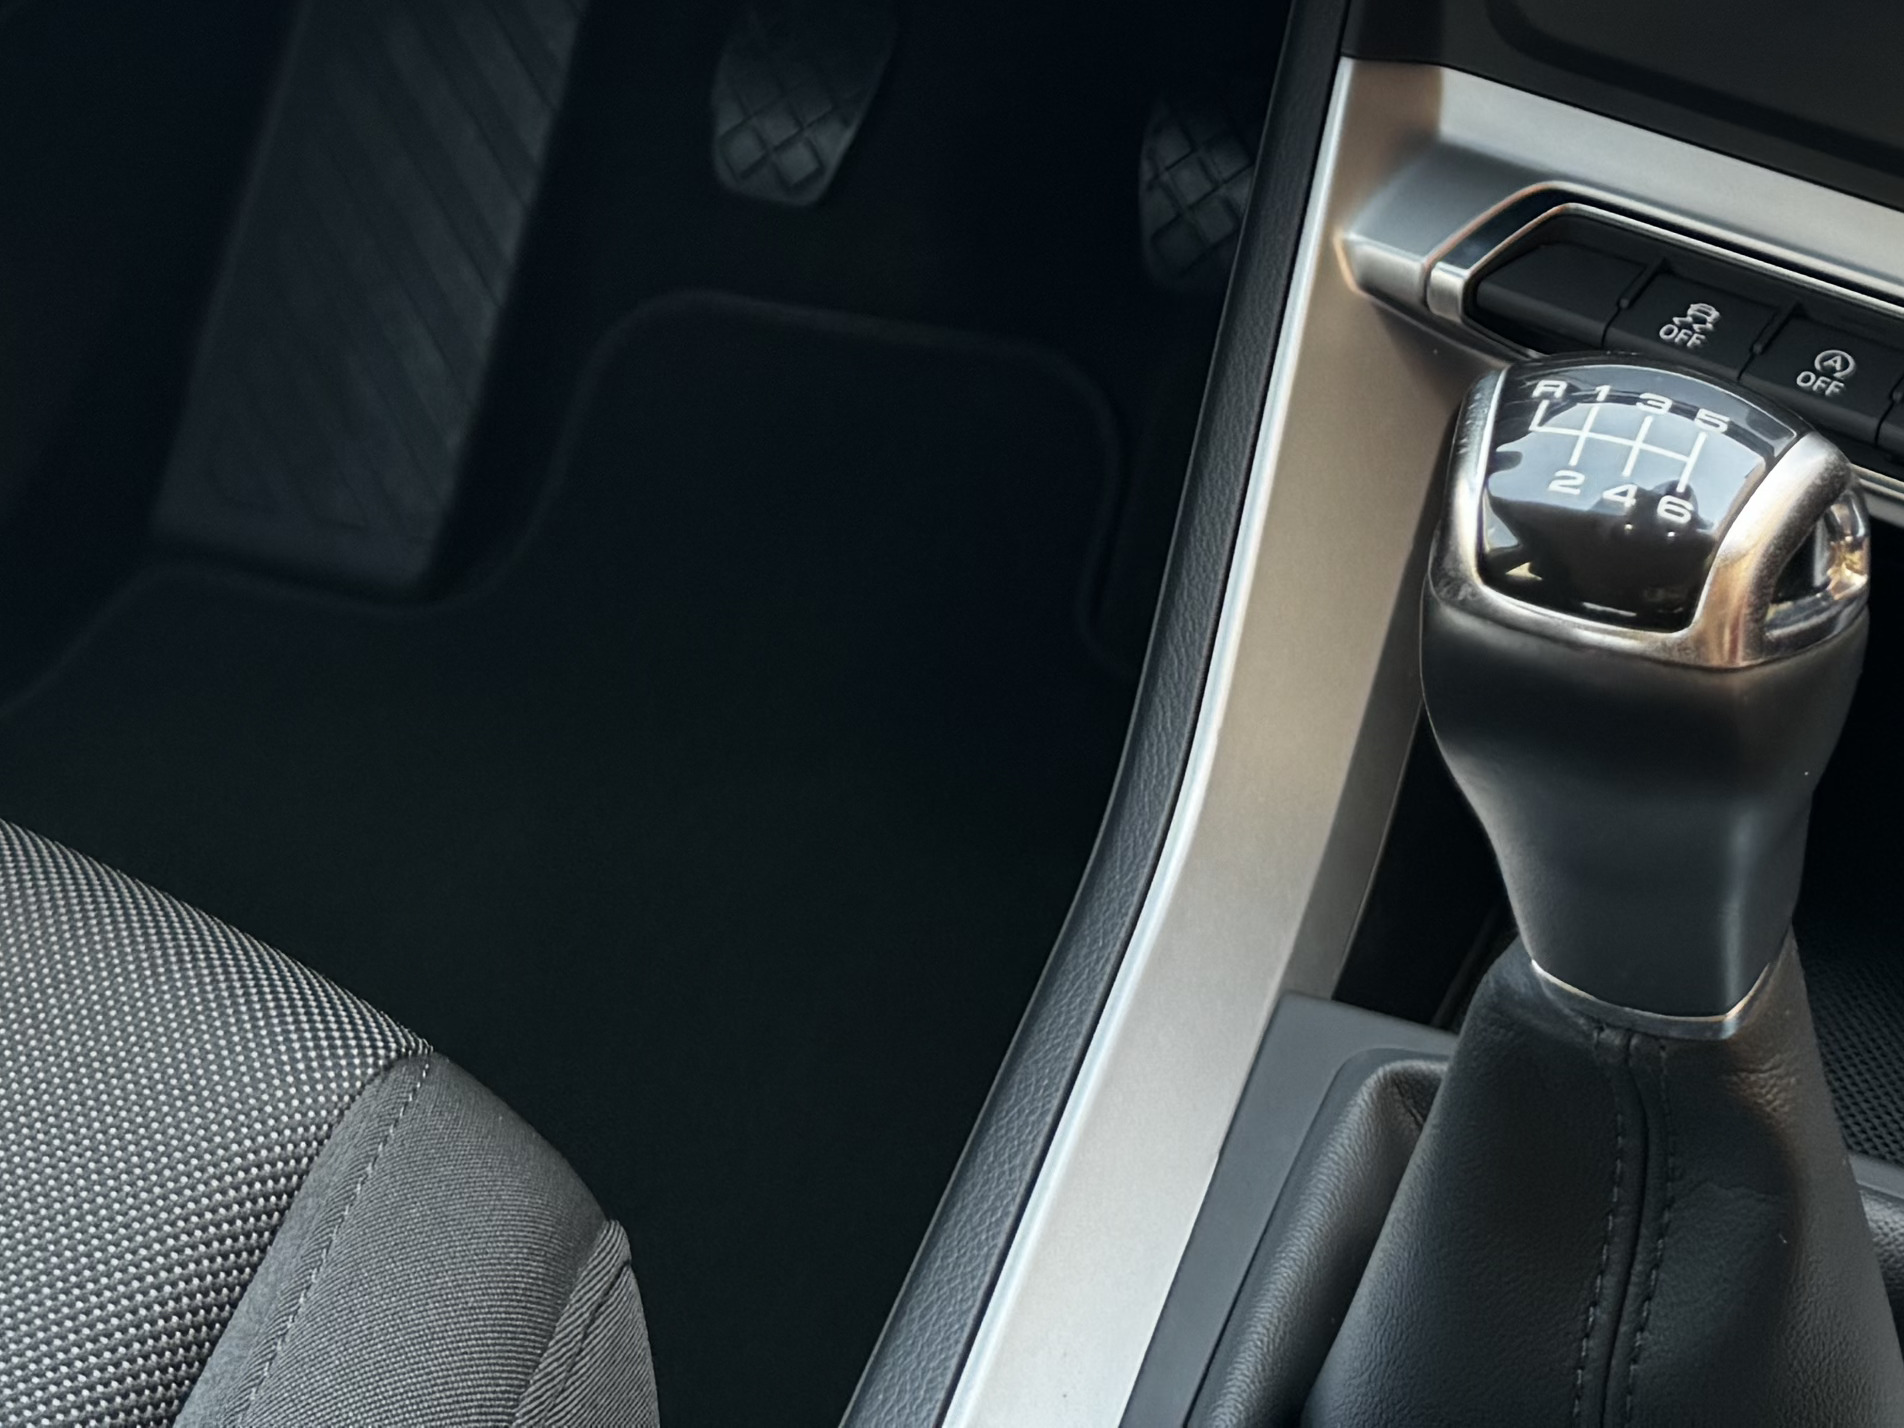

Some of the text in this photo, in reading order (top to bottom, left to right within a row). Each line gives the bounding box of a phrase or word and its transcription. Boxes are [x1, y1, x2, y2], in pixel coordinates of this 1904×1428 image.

[1658, 323, 1706, 350] OFF
[1796, 370, 1845, 396] OFF
[1532, 380, 1731, 434] R 1 3 5
[1548, 469, 1694, 524] 2 4 6
